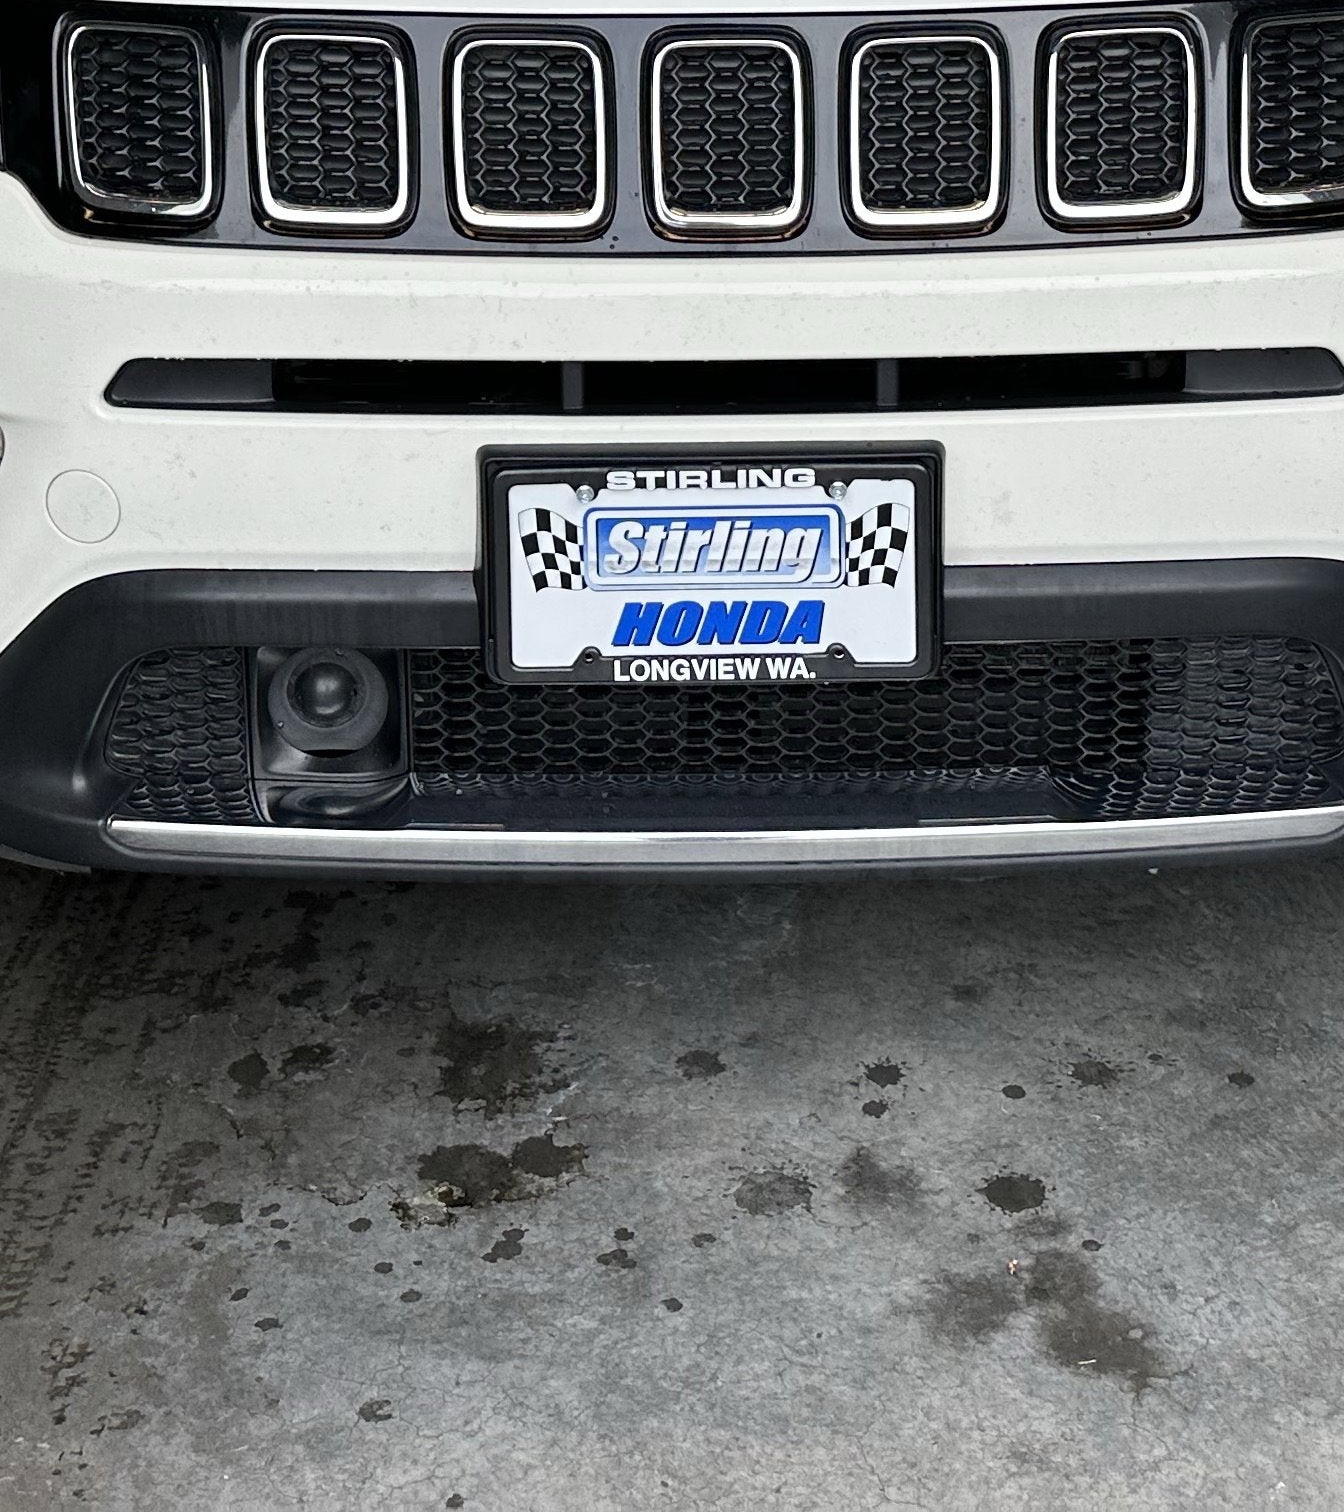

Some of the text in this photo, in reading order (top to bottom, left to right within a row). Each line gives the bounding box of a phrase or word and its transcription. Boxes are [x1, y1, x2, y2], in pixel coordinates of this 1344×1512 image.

[606, 468, 816, 491] STIRLING
[603, 520, 824, 583] Stirling
[611, 599, 825, 646] HONDA
[613, 656, 817, 682] LONGVIEW WA.
